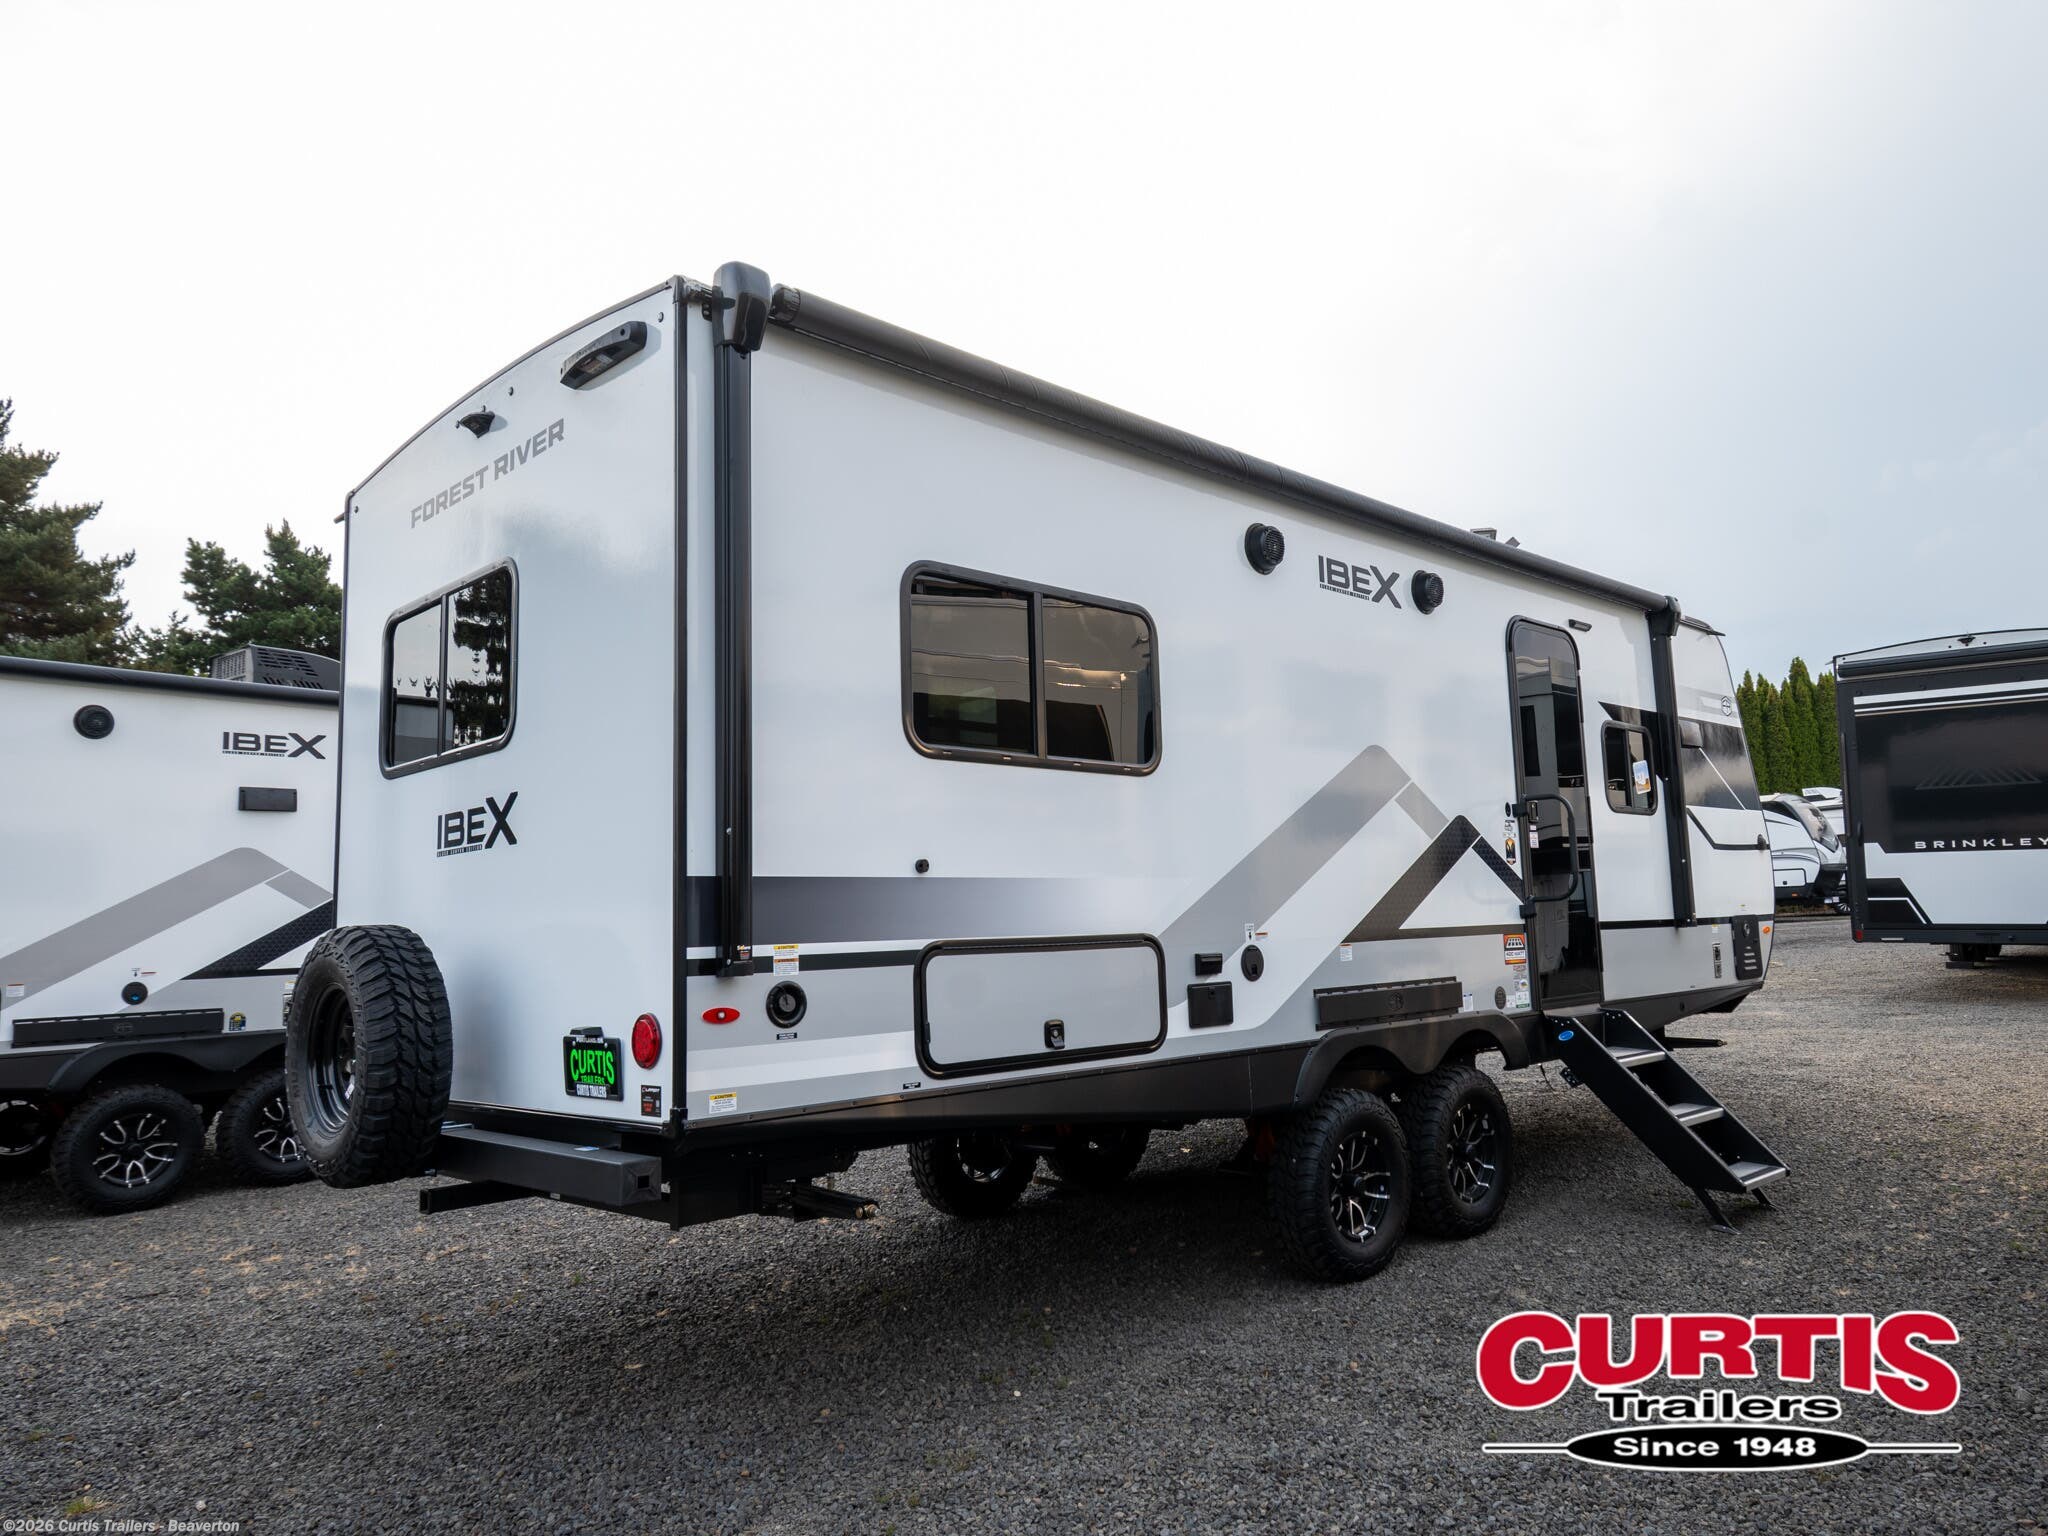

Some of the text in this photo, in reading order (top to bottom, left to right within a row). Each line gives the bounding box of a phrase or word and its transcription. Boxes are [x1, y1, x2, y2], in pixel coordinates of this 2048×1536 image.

[411, 418, 564, 529] FOREST RIVER
[1318, 554, 1402, 609] IBEX
[222, 731, 326, 759] IBEX
[437, 791, 518, 850] IBEX
[1914, 837, 2048, 849] BRINKLEY
[570, 1048, 615, 1085] CURTIS
[581, 1075, 605, 1085] TRAILERS
